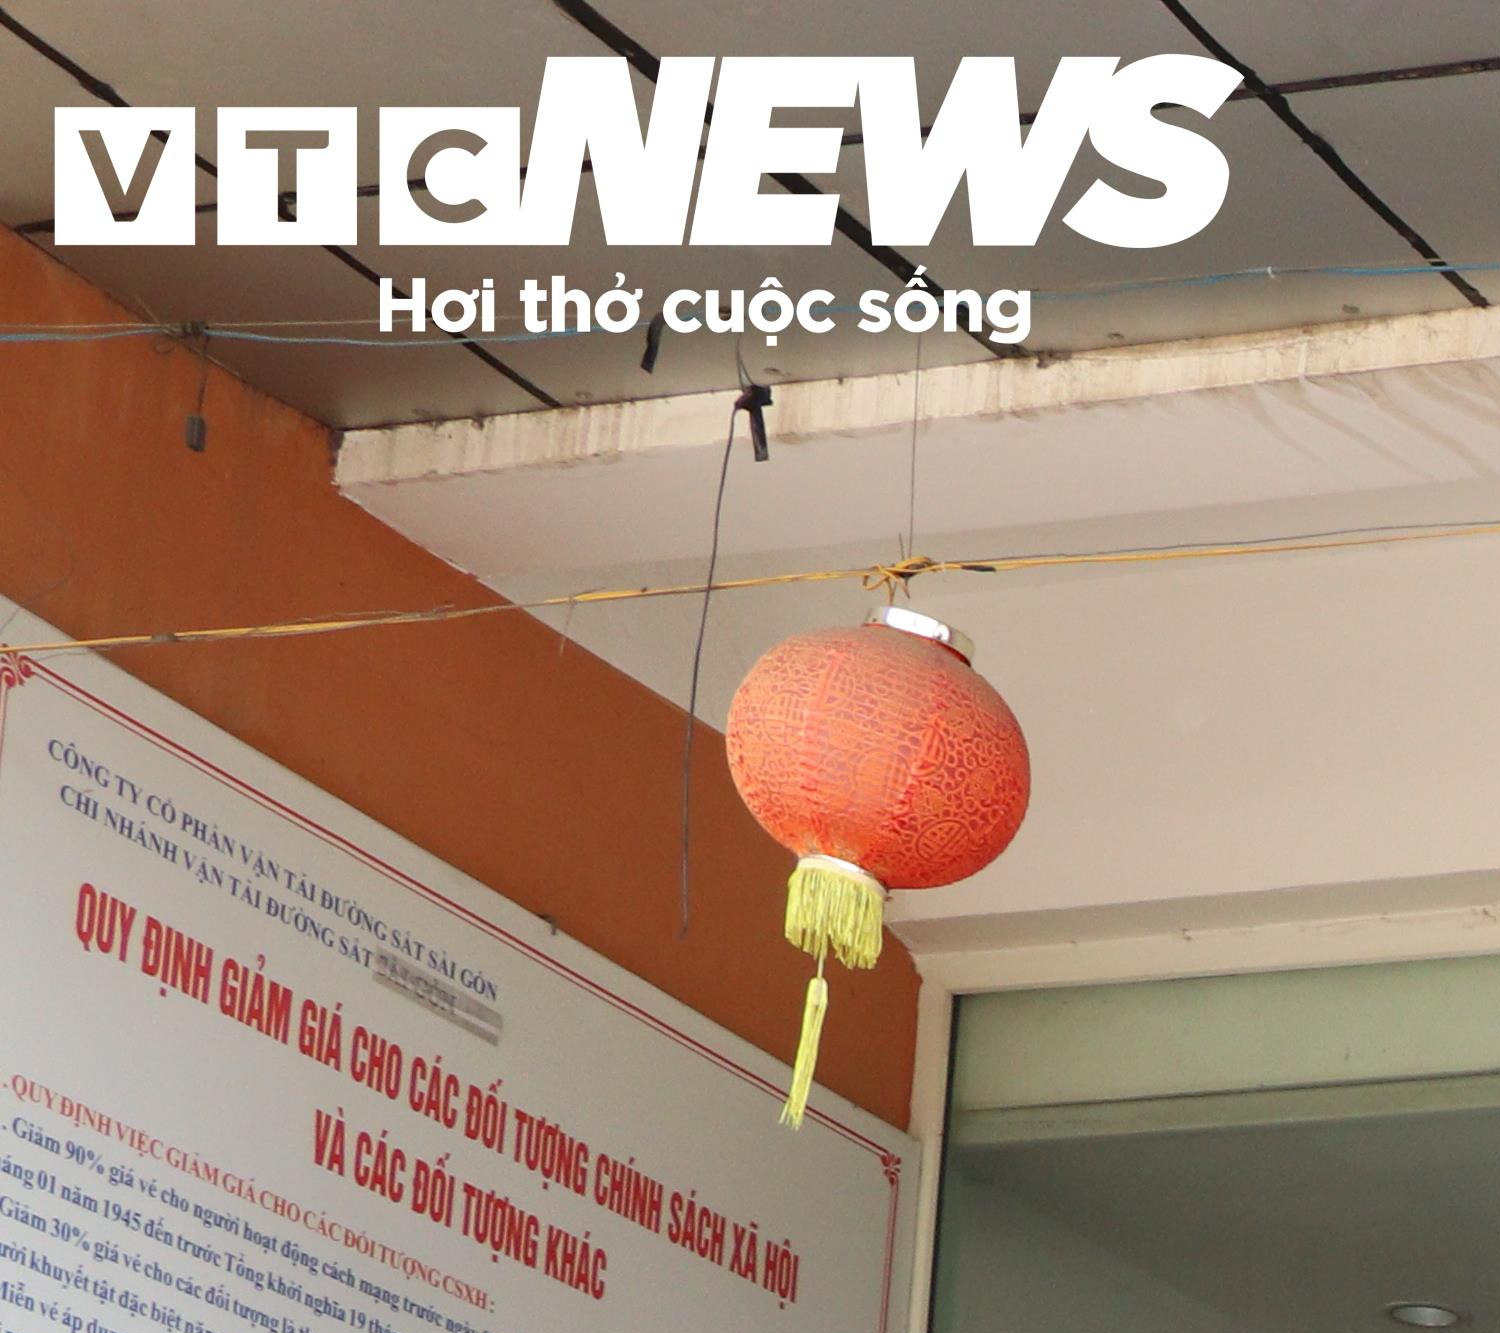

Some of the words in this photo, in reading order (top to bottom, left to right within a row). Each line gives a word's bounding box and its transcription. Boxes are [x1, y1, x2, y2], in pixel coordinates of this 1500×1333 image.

[47, 738, 109, 788] CÔNG
[115, 774, 138, 804] TY
[145, 794, 176, 824] CỔ
[181, 812, 233, 856] PHẦN
[240, 844, 278, 881] VẬN
[283, 868, 316, 902] TẢI
[320, 889, 386, 941] ĐƯỜNG
[390, 929, 424, 961] SẮT
[427, 949, 456, 980] SÀI
[459, 968, 496, 1001] GÒN
[105, 807, 177, 863] NHÁNH
[183, 849, 222, 887] VẬN
[229, 875, 261, 909] TẢI
[265, 896, 334, 947] ĐƯỜNG
[338, 935, 374, 968] SẮT
[74, 882, 135, 960] QUY
[140, 916, 213, 1002] ĐỊNH
[218, 956, 292, 1042] GIẢM
[297, 999, 341, 1070] GIÁ
[349, 1025, 401, 1098] CHO
[408, 1055, 459, 1127] CÁC
[464, 1080, 507, 1152] ĐỐI
[513, 1109, 588, 1194] TƯỢNG
[592, 1154, 663, 1232] CHÍNH
[667, 1191, 725, 1264] SÁCH
[729, 1222, 757, 1280] XÃ
[762, 1240, 800, 1300] HỘI
[313, 1110, 345, 1174] VÀ
[353, 1131, 405, 1201] CÁC
[410, 1157, 454, 1226] ĐỐI
[462, 1183, 540, 1267] TƯỢNG
[543, 1226, 607, 1299] KHÁC
